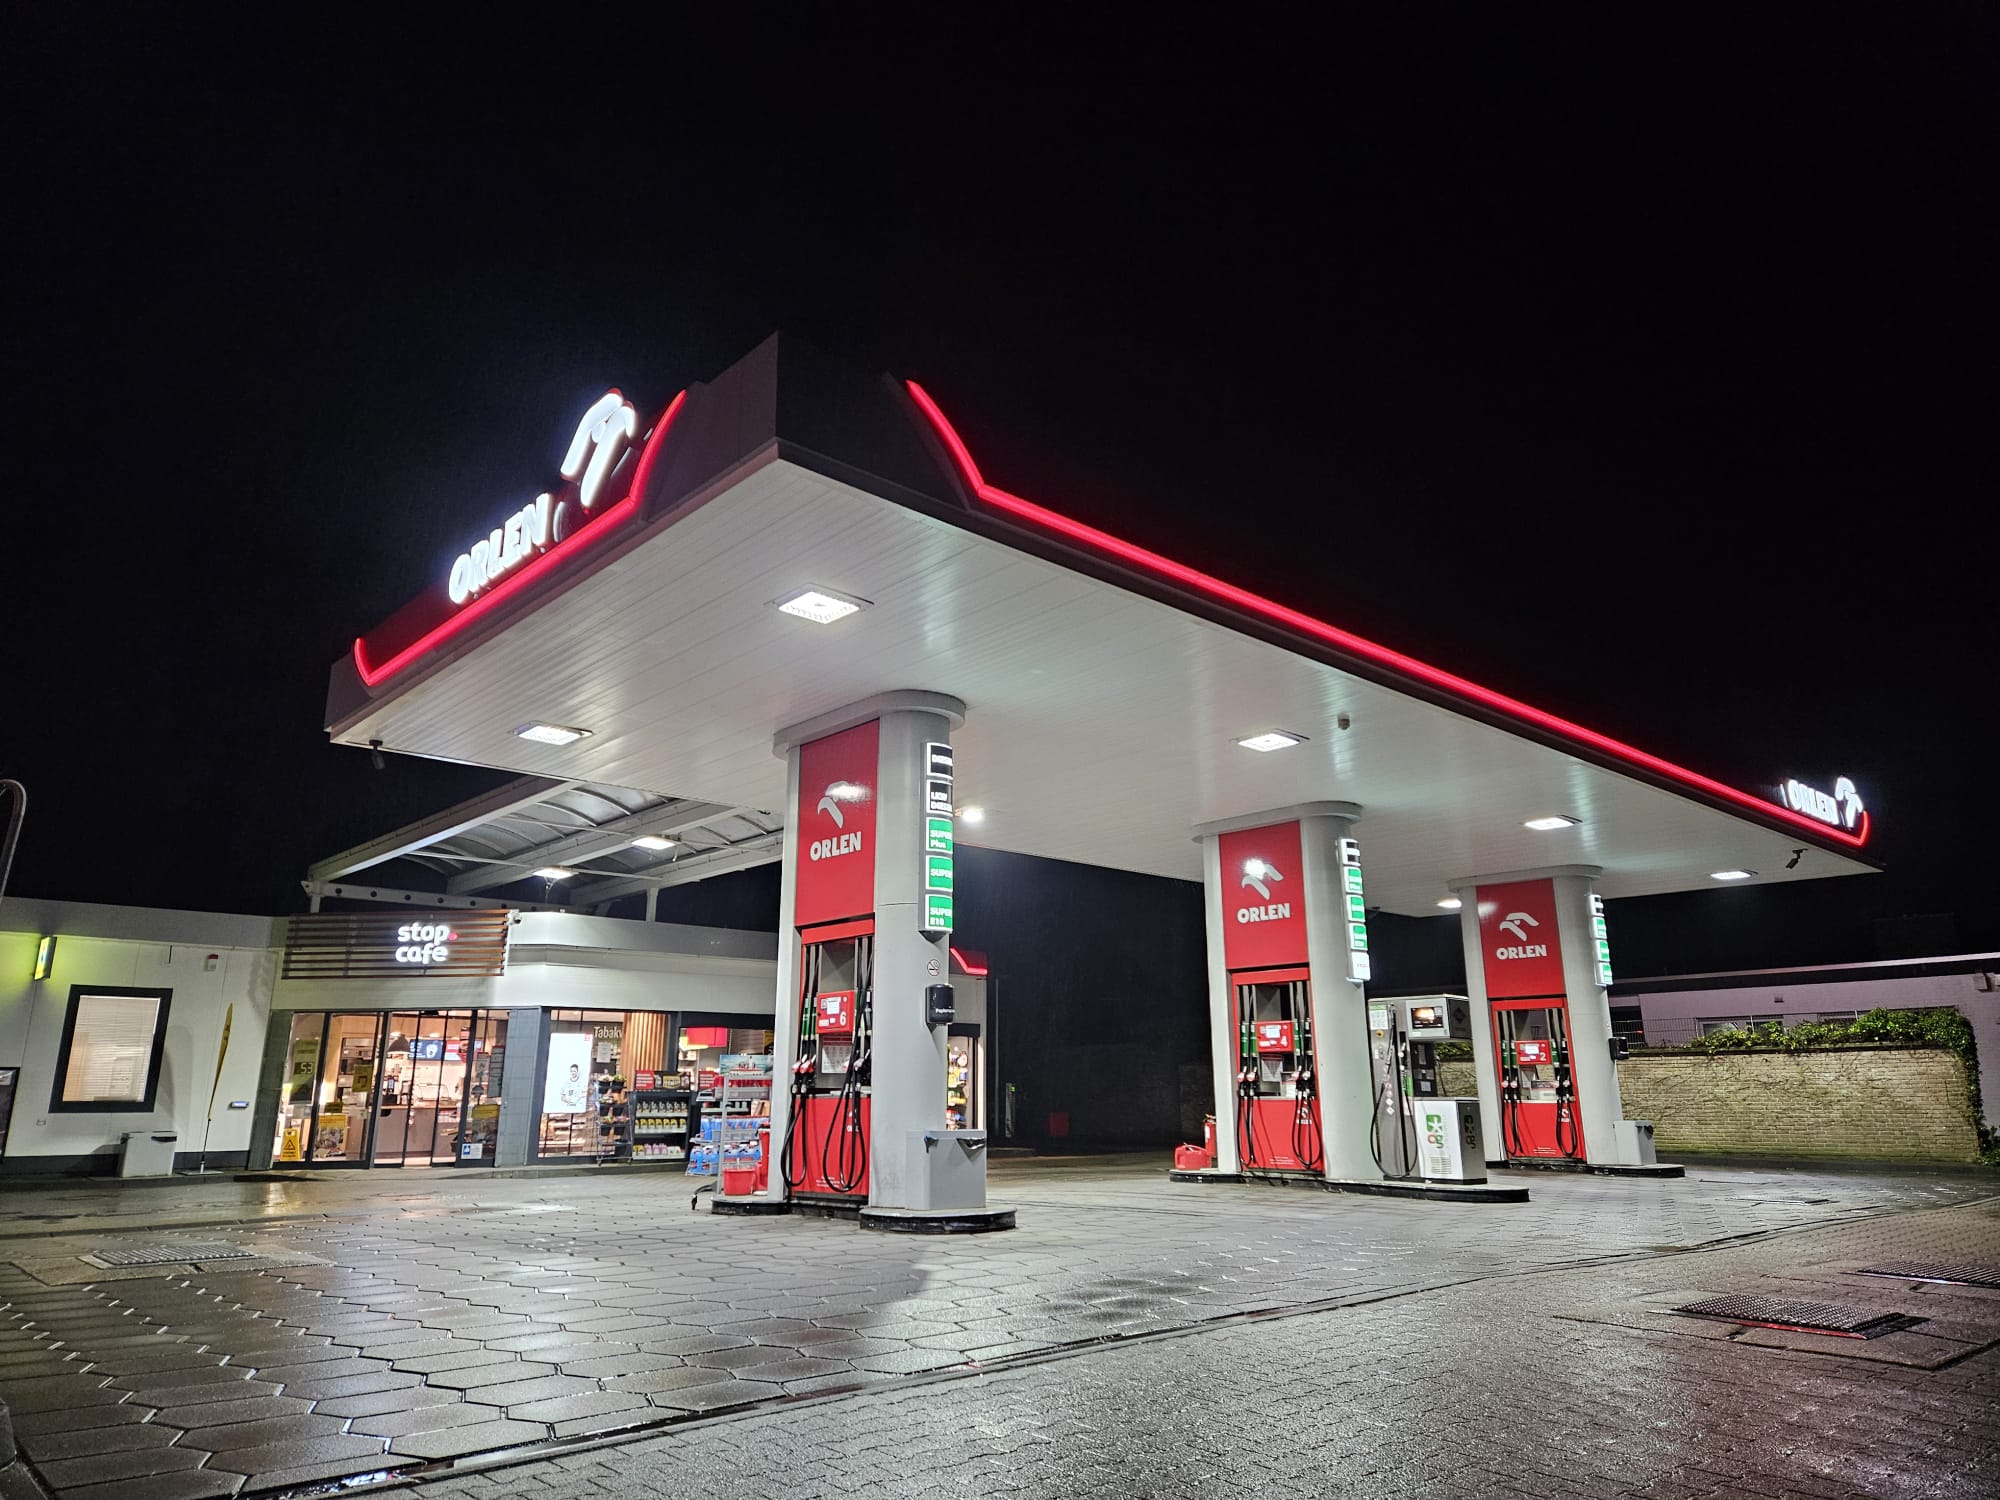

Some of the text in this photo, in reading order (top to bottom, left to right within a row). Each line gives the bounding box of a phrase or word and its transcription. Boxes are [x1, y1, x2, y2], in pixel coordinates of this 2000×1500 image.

[449, 493, 552, 605] ORLEN
[1788, 779, 1840, 825] ORLEN
[810, 831, 862, 862] ORLEN
[1237, 902, 1291, 924] ORLEN
[395, 942, 448, 964] cafe
[1496, 944, 1548, 960] ORLEN
[839, 1011, 847, 1026] 6
[1280, 1036, 1288, 1047] 4
[1540, 1052, 1547, 1061] 2
